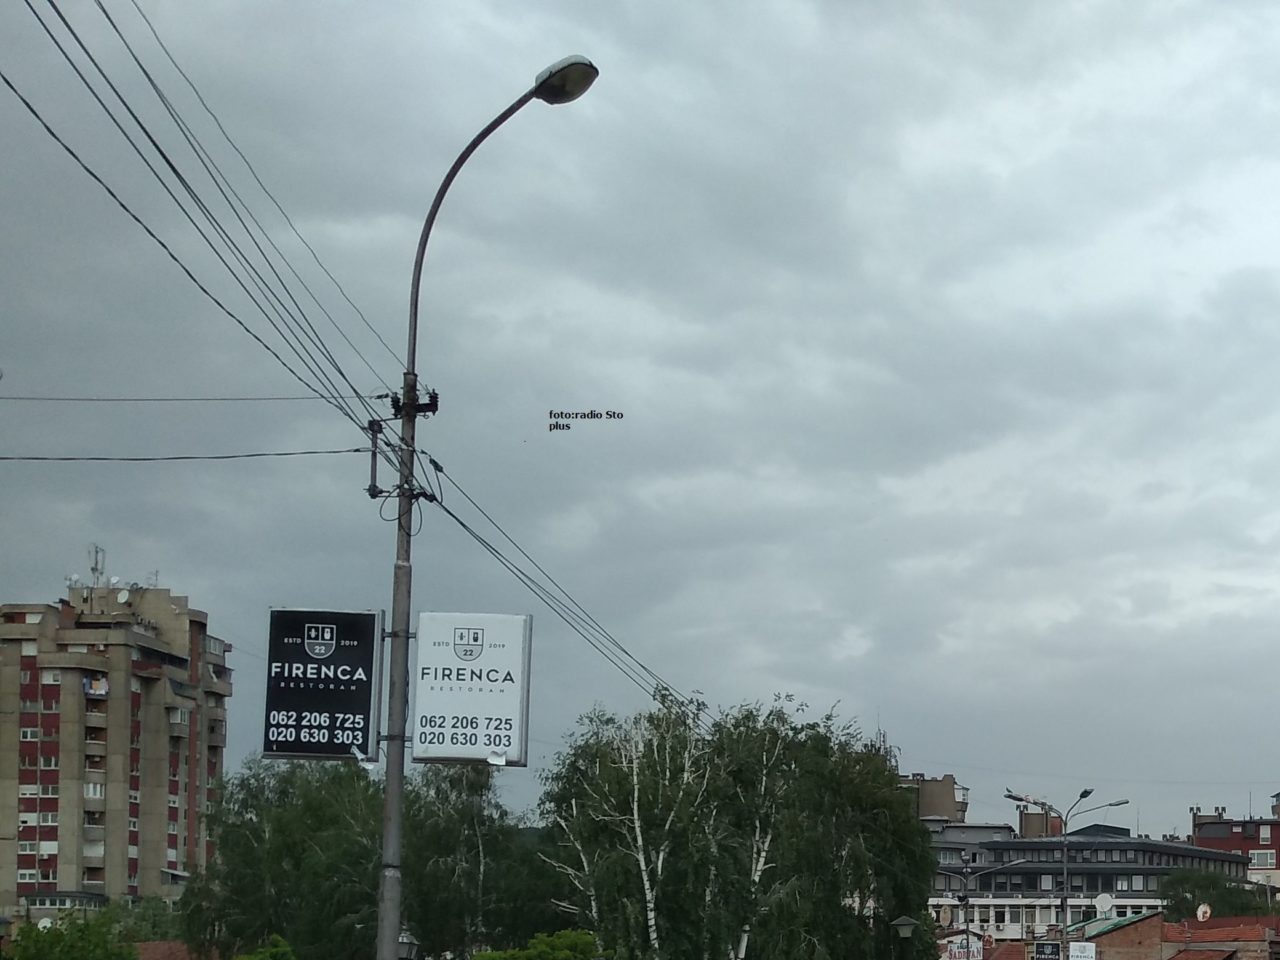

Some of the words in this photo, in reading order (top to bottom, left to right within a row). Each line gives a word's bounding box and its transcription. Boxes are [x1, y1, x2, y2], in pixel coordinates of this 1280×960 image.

[314, 645, 325, 653] 22
[271, 662, 367, 681] FIRENCA
[421, 667, 515, 684] FIRENCA
[280, 682, 356, 691] RESTORAN
[430, 685, 505, 693] RESTORAN
[269, 711, 297, 725] 062
[301, 712, 330, 727] 206
[334, 713, 364, 728] 725
[420, 715, 446, 729] 062
[451, 716, 479, 729] 206
[484, 717, 513, 731] 725
[269, 727, 296, 741] 020
[300, 729, 328, 743] 630
[333, 730, 363, 744] 303
[419, 731, 445, 745] 020
[450, 733, 478, 746] 630
[483, 734, 512, 747] 303
